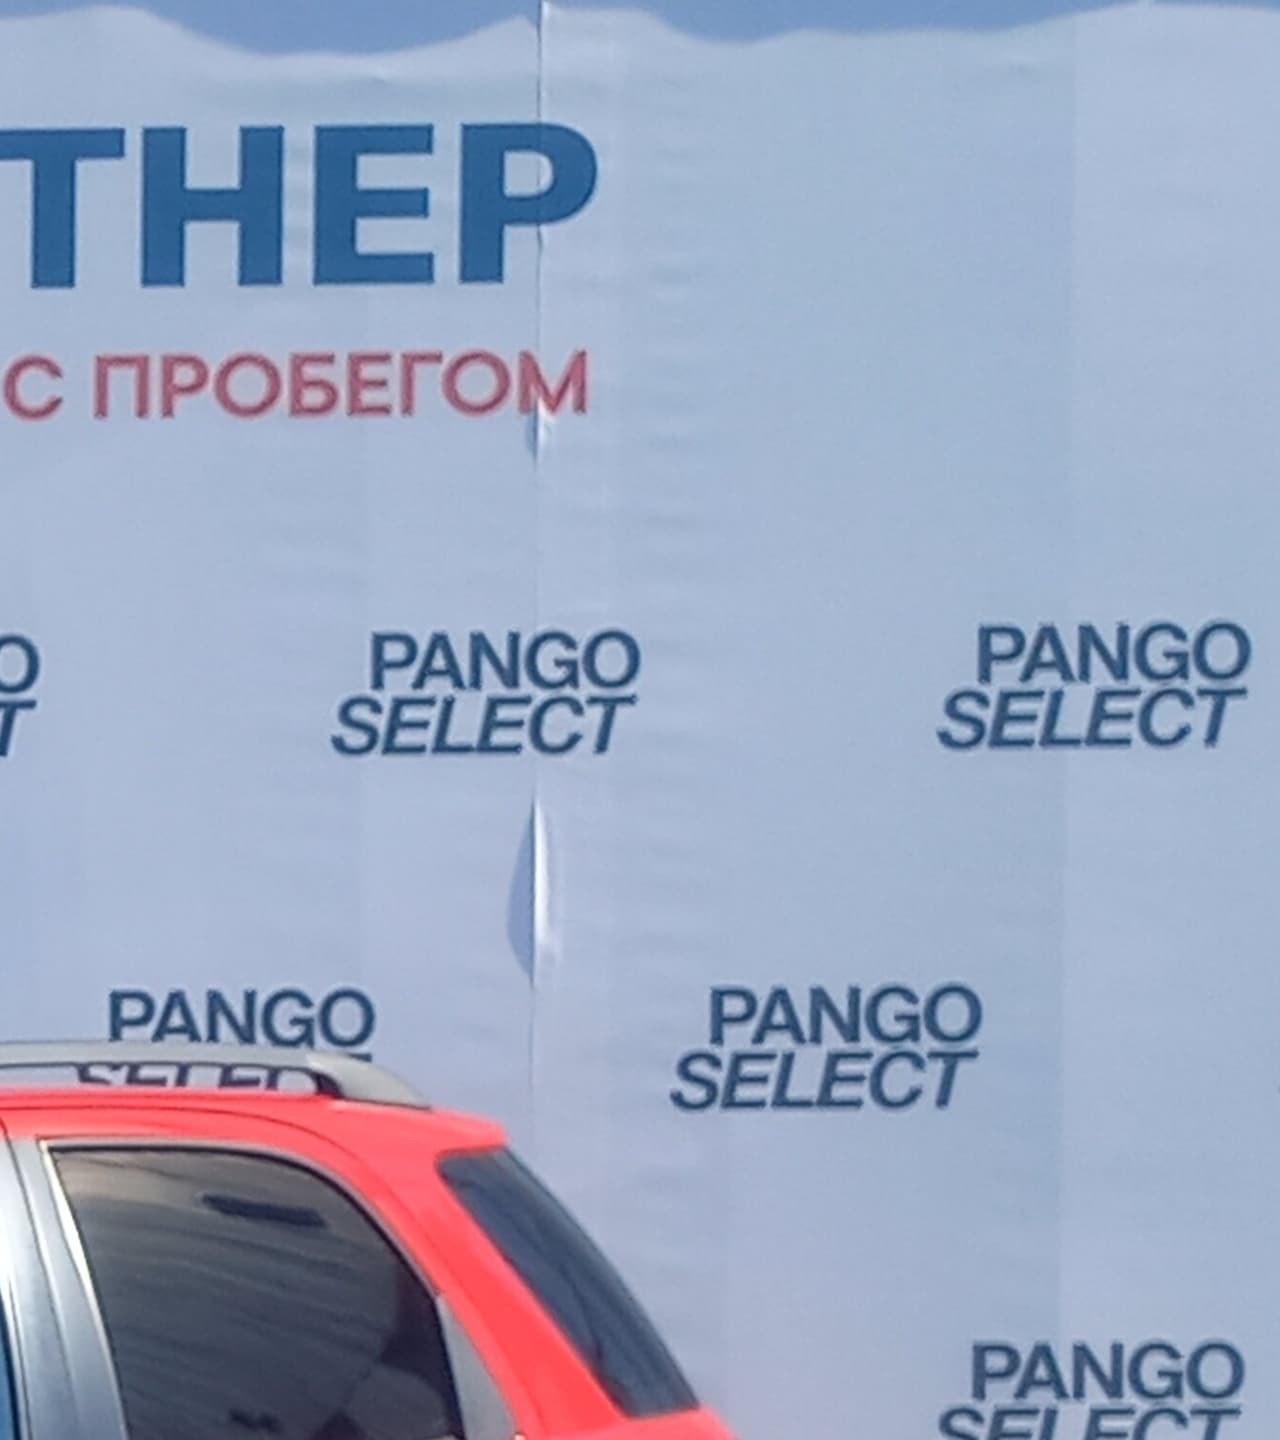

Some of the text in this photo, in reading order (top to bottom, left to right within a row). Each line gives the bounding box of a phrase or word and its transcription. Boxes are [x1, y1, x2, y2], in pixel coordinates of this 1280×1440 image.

[3, 355, 64, 421] С
[93, 350, 588, 420] ПРОБЕГОМ
[370, 629, 642, 692] PANGO
[977, 621, 1253, 687] PANGO
[331, 693, 640, 757] SELECT
[936, 686, 1250, 751] SELECT
[108, 987, 377, 1049] PANGO
[709, 984, 983, 1049] PANGO
[670, 1048, 981, 1113] SELECT
[971, 1340, 1246, 1405] PANGO
